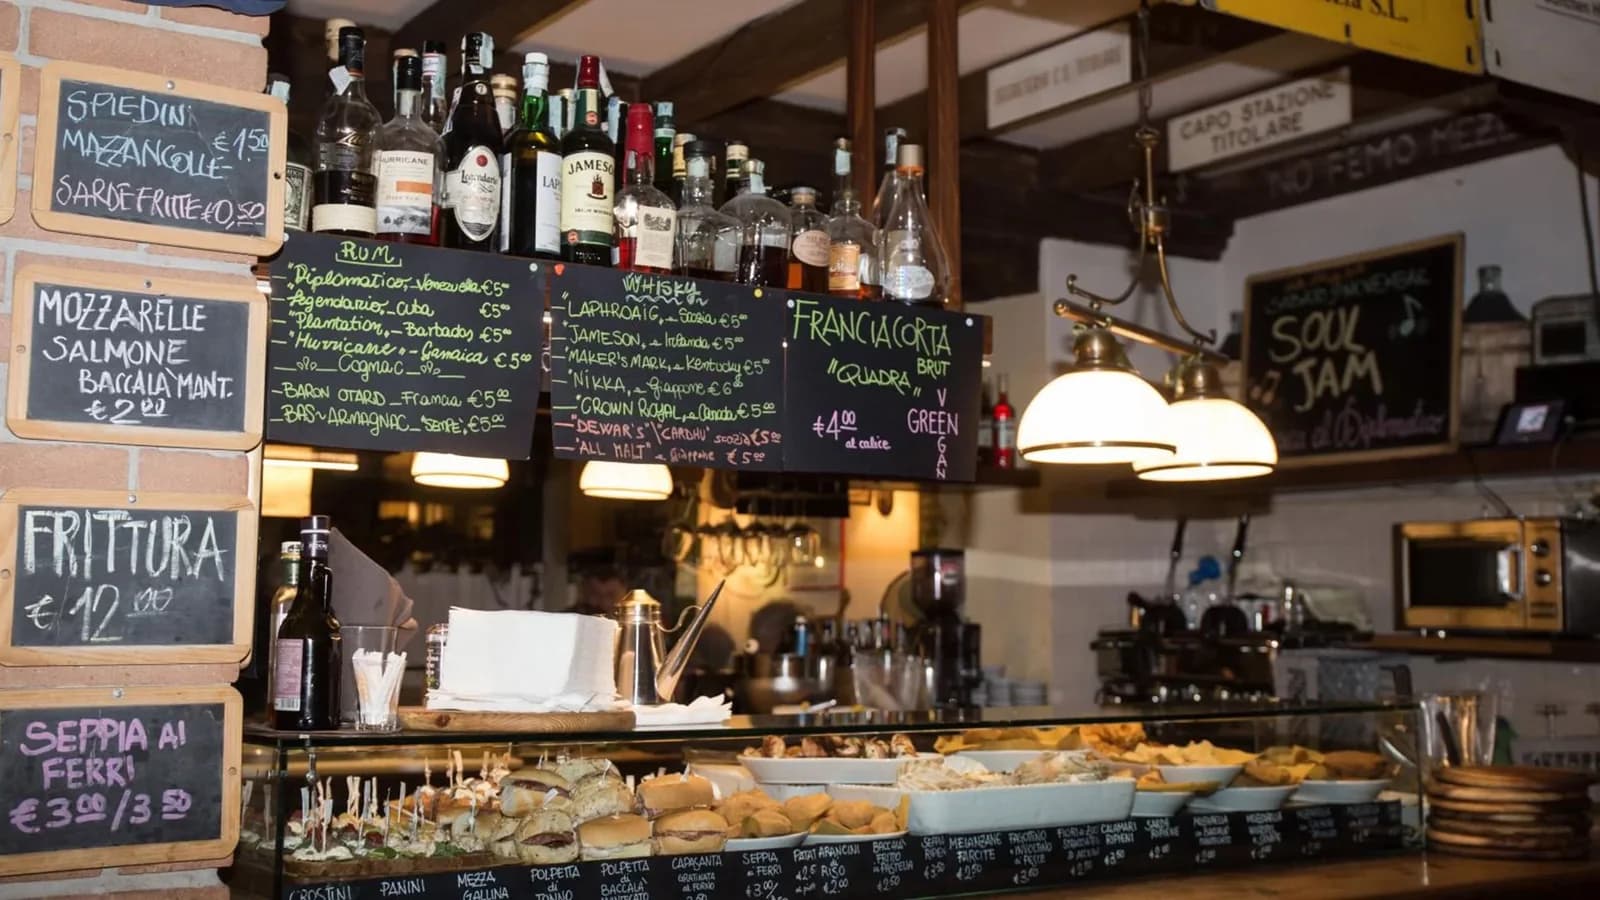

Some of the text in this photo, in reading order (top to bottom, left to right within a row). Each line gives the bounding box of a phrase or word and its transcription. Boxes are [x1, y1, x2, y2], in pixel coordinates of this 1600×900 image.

[1180, 84, 1335, 141] CAPO STAZIONE
[1211, 112, 1302, 153] TITOLARE
[1328, 137, 1416, 183] FEMO
[56, 174, 135, 212] SARDE
[136, 186, 201, 220] FRITTE
[341, 241, 395, 263] RUM
[38, 289, 208, 334] MOZZARELLE
[396, 299, 435, 317] Cuba
[402, 322, 474, 343] Barbados
[793, 299, 952, 356] FRANCIACORTA
[1269, 305, 1365, 363] SOUL
[665, 331, 710, 349] Irlanda
[42, 336, 191, 369] SALMONE
[338, 354, 404, 382] Cognac
[686, 354, 741, 376] Kentucky
[917, 357, 951, 380] BRUT
[176, 370, 234, 400] MANT.
[1292, 350, 1383, 412] JAM
[282, 382, 330, 398] BARON
[338, 388, 386, 406] OTARD
[401, 391, 462, 407] Francia
[907, 408, 959, 437] GREEN
[845, 435, 891, 450] al calice
[24, 509, 230, 581] FRITTURA
[20, 718, 186, 756] SEPPIA AI
[42, 755, 135, 791] FERRI
[600, 860, 650, 876] POLPETTA
[742, 852, 778, 865] SEPPIA
[457, 870, 496, 888] MEZZA
[530, 865, 580, 882] POLPETTA
[620, 875, 631, 884] di
[756, 864, 782, 876] FERRI
[821, 865, 846, 879] RISO
[380, 878, 426, 897] PANINI
[463, 887, 509, 900] GALLINA
[547, 880, 559, 892] di
[692, 882, 715, 891] FORNO
